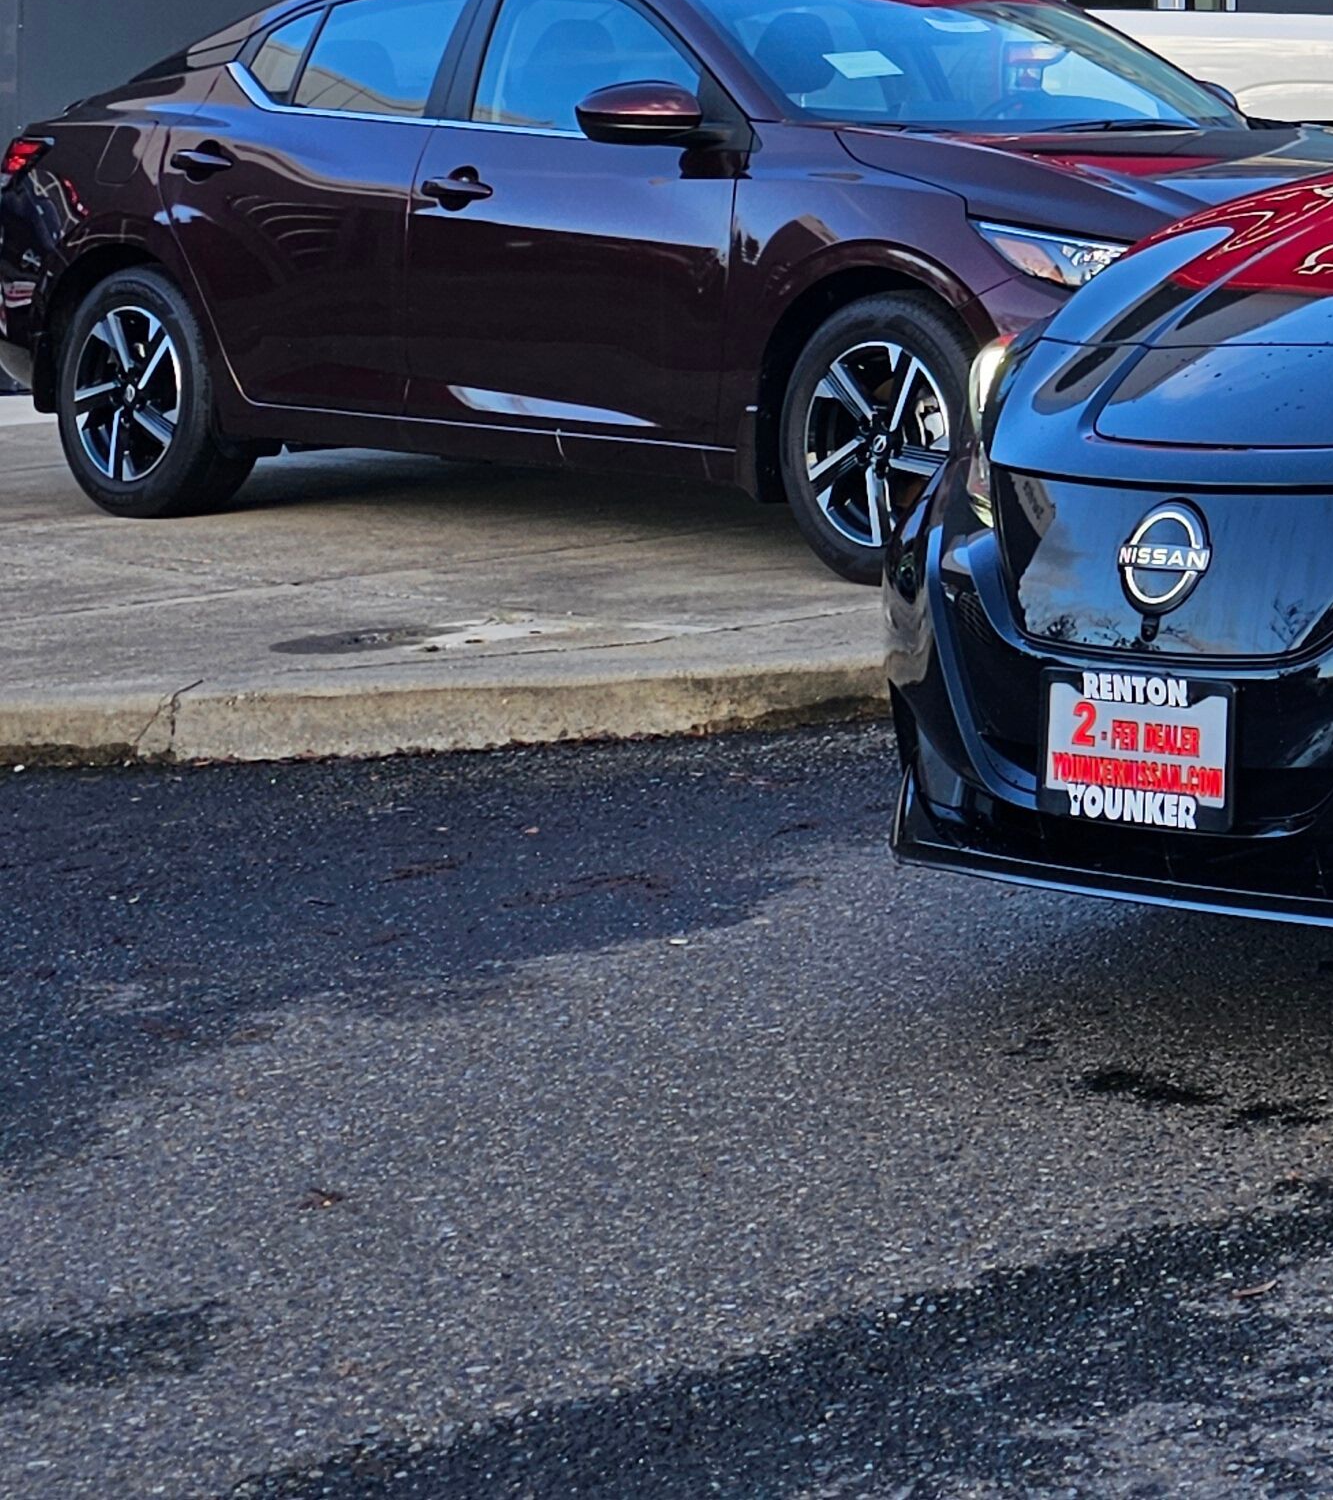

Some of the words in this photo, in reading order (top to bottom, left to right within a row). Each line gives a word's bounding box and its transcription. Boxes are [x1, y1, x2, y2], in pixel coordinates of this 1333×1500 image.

[1118, 546, 1208, 569] NISSAN
[1082, 672, 1189, 707] RENTON
[1143, 722, 1200, 758] DEALER
[1052, 751, 1223, 799] YOUNKERNISSAN.COM
[1066, 782, 1197, 830] YOUNKER
